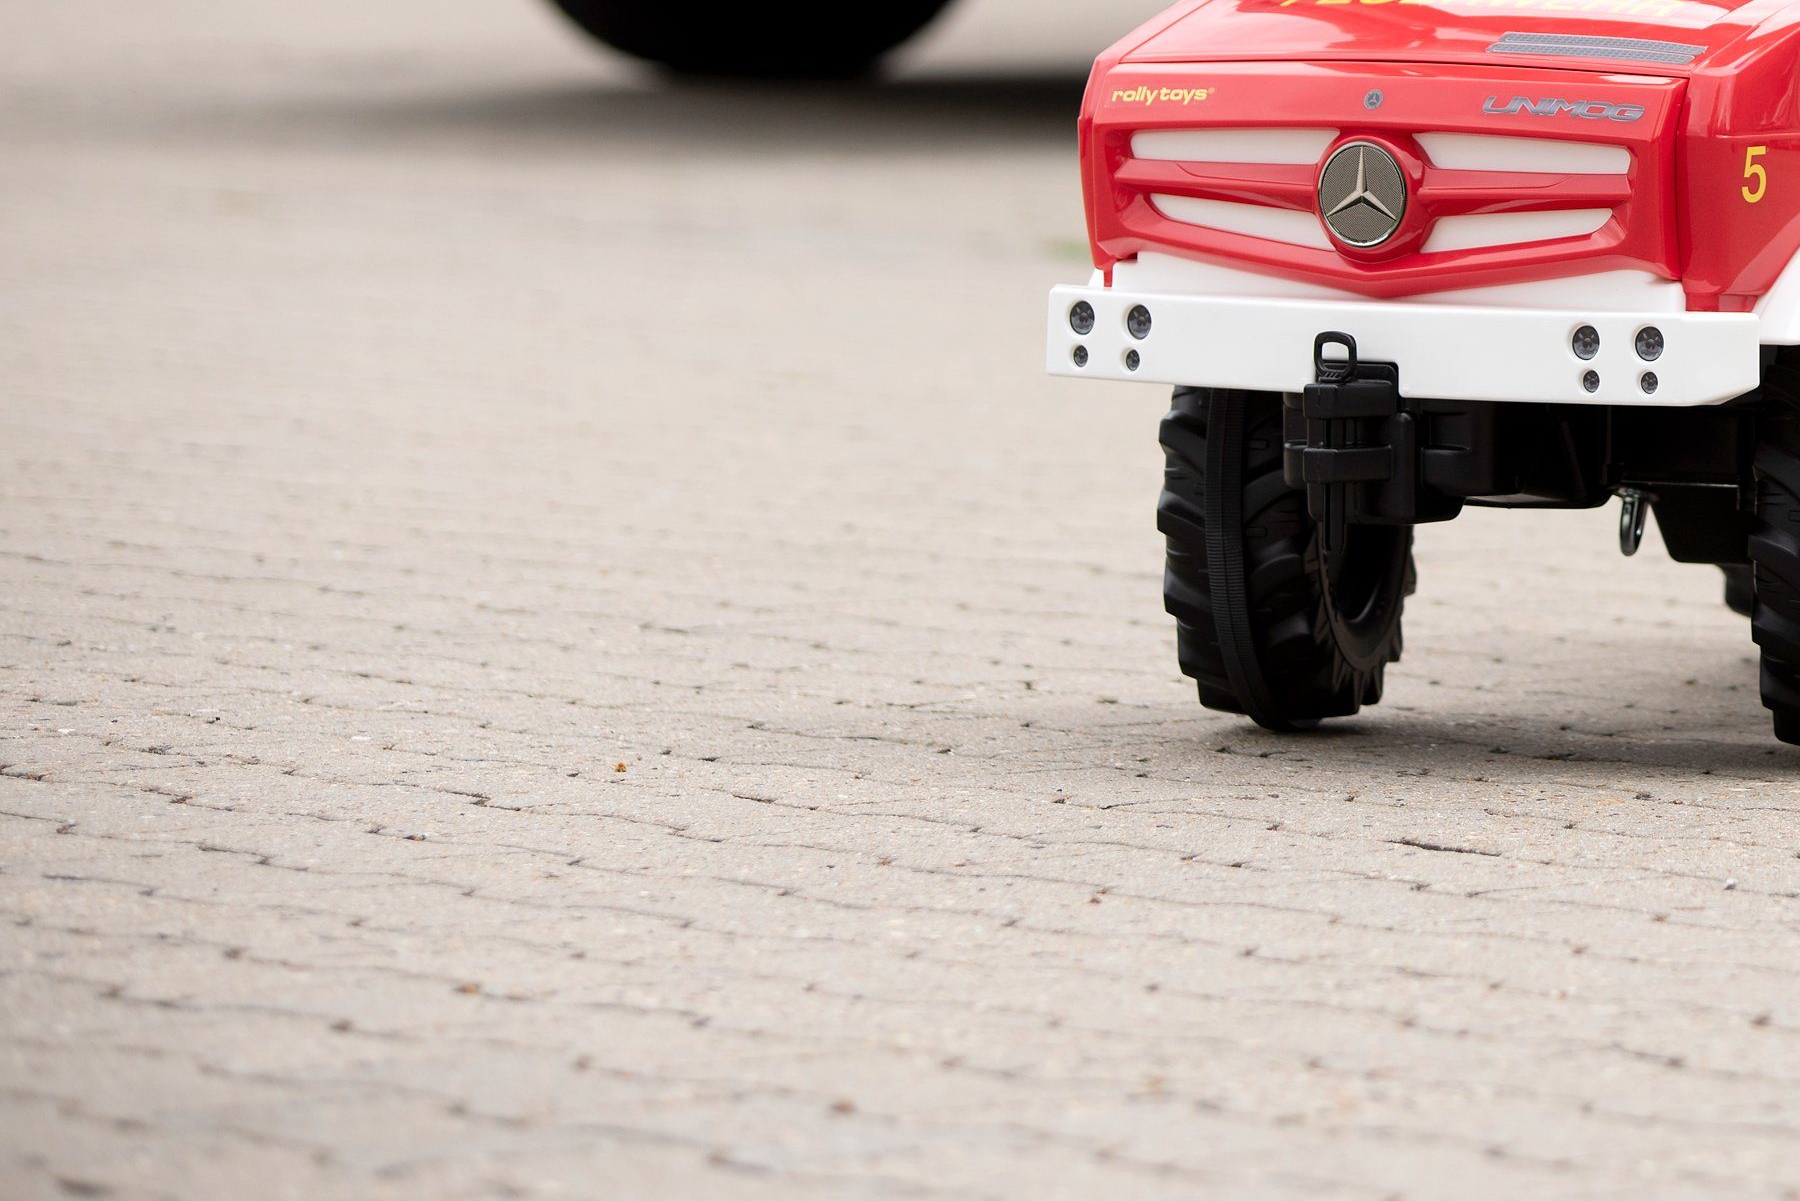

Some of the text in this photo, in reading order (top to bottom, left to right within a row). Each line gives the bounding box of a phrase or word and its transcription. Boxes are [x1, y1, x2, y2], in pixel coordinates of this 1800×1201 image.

[1111, 85, 1159, 106] rolly
[1481, 95, 1645, 122] UNIMOG
[1741, 145, 1768, 204] 5
